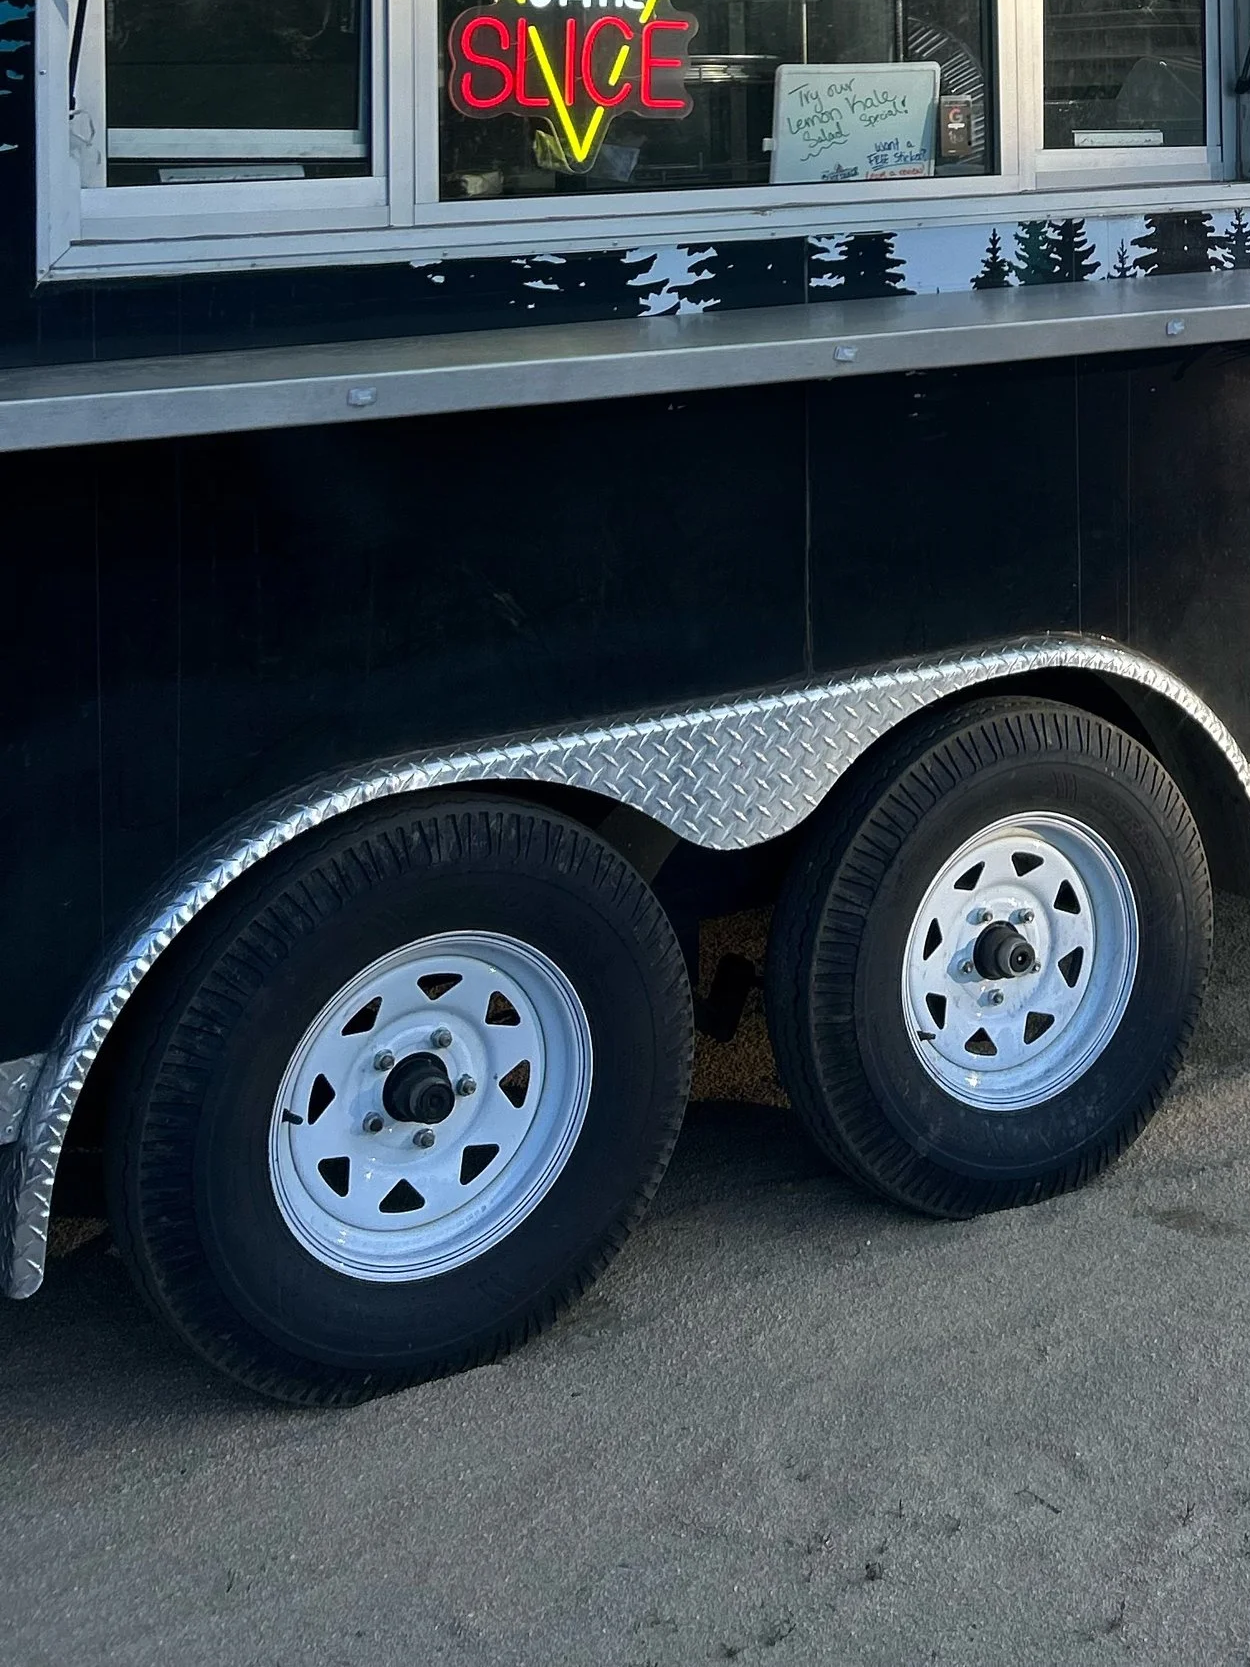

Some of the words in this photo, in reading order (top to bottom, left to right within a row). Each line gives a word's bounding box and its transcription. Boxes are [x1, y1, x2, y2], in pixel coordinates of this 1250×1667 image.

[461, 16, 689, 108] SLICE
[788, 83, 823, 113] Try
[827, 78, 855, 97] our
[787, 108, 843, 134] Lemon
[845, 89, 897, 114] Kale
[949, 107, 963, 123] G
[803, 122, 850, 148] Salad
[906, 140, 914, 148] a
